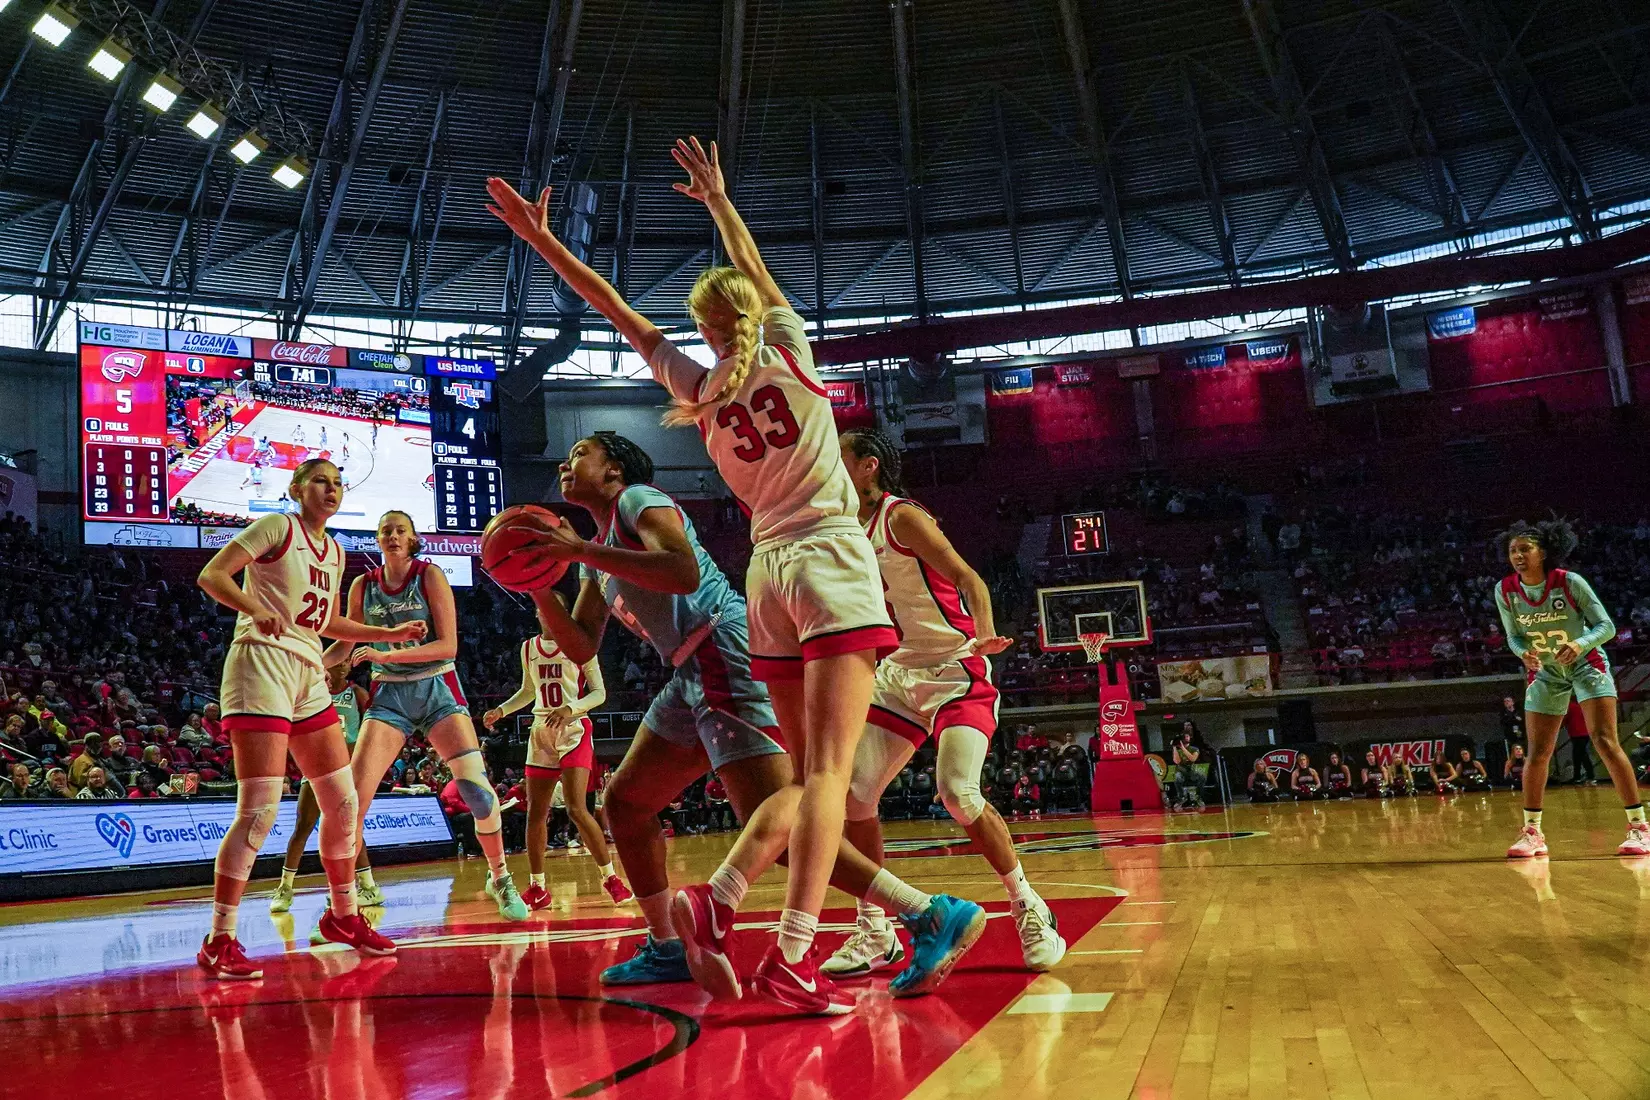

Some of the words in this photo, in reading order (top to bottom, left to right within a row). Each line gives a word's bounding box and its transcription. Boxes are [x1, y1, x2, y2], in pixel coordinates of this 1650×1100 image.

[184, 333, 226, 348] LOGAN
[181, 345, 221, 353] ALUMINUM
[1251, 344, 1288, 356] LIBERTY
[359, 352, 393, 362] CHEETAH
[192, 359, 201, 372] 4
[254, 362, 269, 372] 1ST
[374, 361, 393, 369] Clean
[291, 367, 316, 382] 7:41
[1005, 375, 1018, 384] FIU
[415, 379, 423, 391] 4
[116, 389, 132, 413] 5
[90, 421, 98, 430] 0
[105, 422, 129, 431] FOULS
[462, 418, 476, 440] 4
[716, 384, 800, 463] 33
[90, 434, 113, 442] PLAYER
[142, 437, 161, 445] FOULS
[98, 448, 103, 459] 1
[125, 450, 132, 460] 0
[150, 451, 158, 461] 0
[437, 444, 444, 454] 0
[448, 445, 468, 454] FOULS
[97, 462, 104, 472] 3
[125, 463, 132, 474] 0
[151, 465, 158, 475] 0
[446, 469, 453, 479] 3
[467, 471, 474, 480] 0
[488, 472, 495, 481] 0
[96, 475, 106, 485] 10
[125, 476, 133, 487] 0
[151, 478, 159, 488] 0
[445, 481, 455, 490] 15
[468, 483, 475, 492] 0
[489, 484, 495, 493] 0
[94, 488, 108, 498] 23
[126, 489, 133, 499] 0
[151, 490, 159, 501] 0
[469, 494, 475, 504] 0
[489, 496, 496, 505] 0
[95, 502, 108, 512] 33
[126, 503, 133, 514] 0
[152, 504, 159, 515] 0
[445, 505, 457, 514] 22
[469, 506, 476, 515] 0
[490, 507, 497, 516] 0
[446, 517, 457, 526] 23
[470, 518, 477, 527] 0
[1075, 517, 1101, 529] 7:41
[114, 539, 172, 547] MOVERS
[204, 532, 234, 543] Prairie
[1074, 530, 1099, 551] 21
[309, 564, 330, 593] WKU
[295, 591, 328, 633] 23
[538, 664, 562, 679] WKU
[540, 682, 563, 708] 10
[622, 714, 641, 722] GUEST
[1269, 755, 1289, 764] WKU
[1370, 740, 1445, 768] WKU
[376, 814, 411, 828] Gilbert
[410, 812, 436, 827] Clinic
[9, 829, 59, 850] Clinic
[143, 824, 197, 844] Graves
